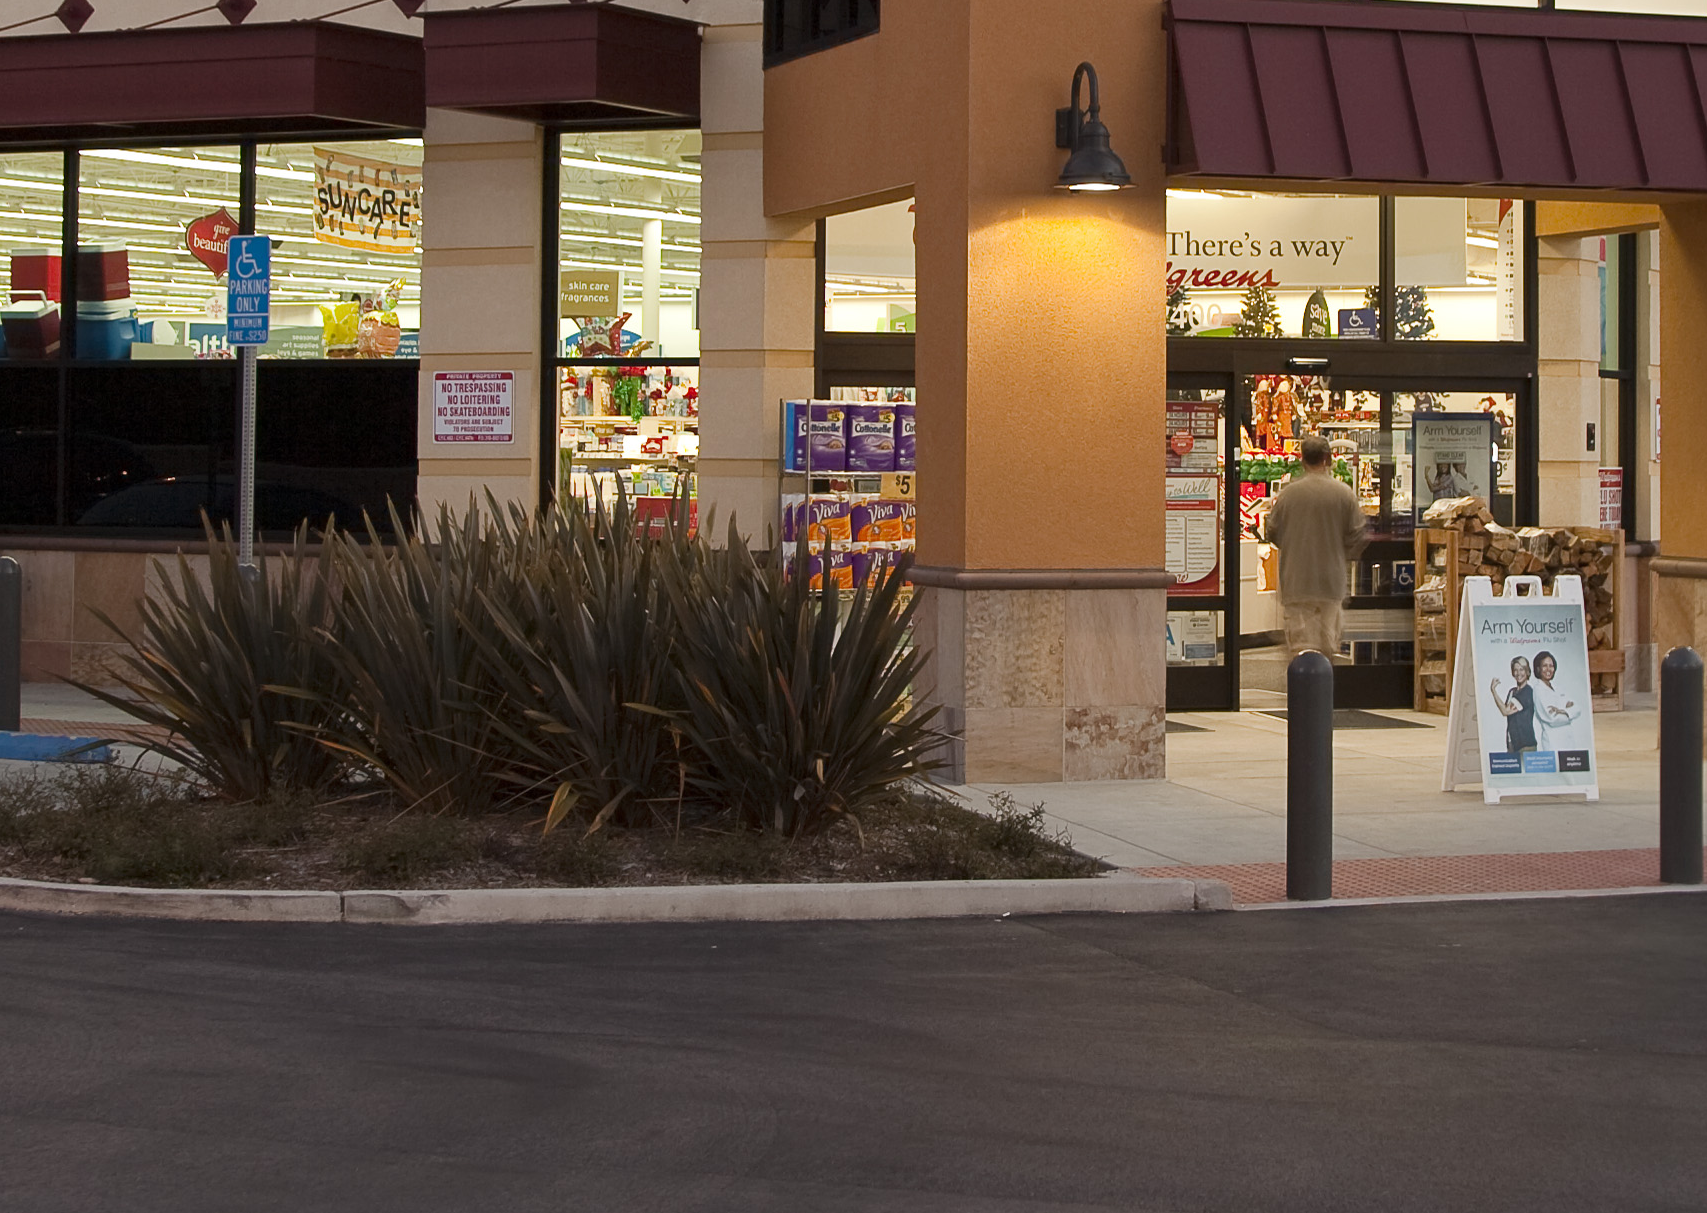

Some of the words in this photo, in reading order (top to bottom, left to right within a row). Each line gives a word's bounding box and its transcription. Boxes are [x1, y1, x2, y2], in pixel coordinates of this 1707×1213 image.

[317, 181, 412, 228] SUNCARE
[214, 221, 230, 240] give
[193, 233, 228, 255] beautif
[1166, 230, 1262, 257] There's
[1269, 240, 1284, 257] a
[1291, 240, 1346, 266] way
[230, 279, 268, 295] PARKING
[568, 280, 588, 290] skin
[589, 282, 610, 291] care
[1166, 262, 1281, 296] greens
[236, 296, 260, 312] ONLY
[560, 292, 610, 304] fragrances
[1310, 303, 1328, 325] save
[233, 317, 263, 328] MINIMUM
[229, 330, 244, 341] FINE
[441, 383, 452, 393] NO
[454, 382, 507, 393] TRESPASSING
[447, 395, 458, 405] NO
[460, 395, 501, 405] LOITERING
[437, 407, 448, 417] NO
[449, 406, 511, 417] SKATEBOARDING
[801, 422, 842, 433] Cttonelle
[854, 423, 892, 434] Cottonelle
[1423, 426, 1444, 436] Arm
[1445, 425, 1482, 436] Yourself
[895, 475, 911, 495] $5
[1609, 489, 1622, 505] SHOT
[813, 503, 840, 524] Viva
[868, 504, 894, 524] Viva
[901, 503, 916, 523] Viv
[1599, 506, 1607, 522] ERE
[1481, 619, 1513, 635] Arm
[1515, 618, 1574, 635] Yourself
[1509, 637, 1541, 645] Walgreens
